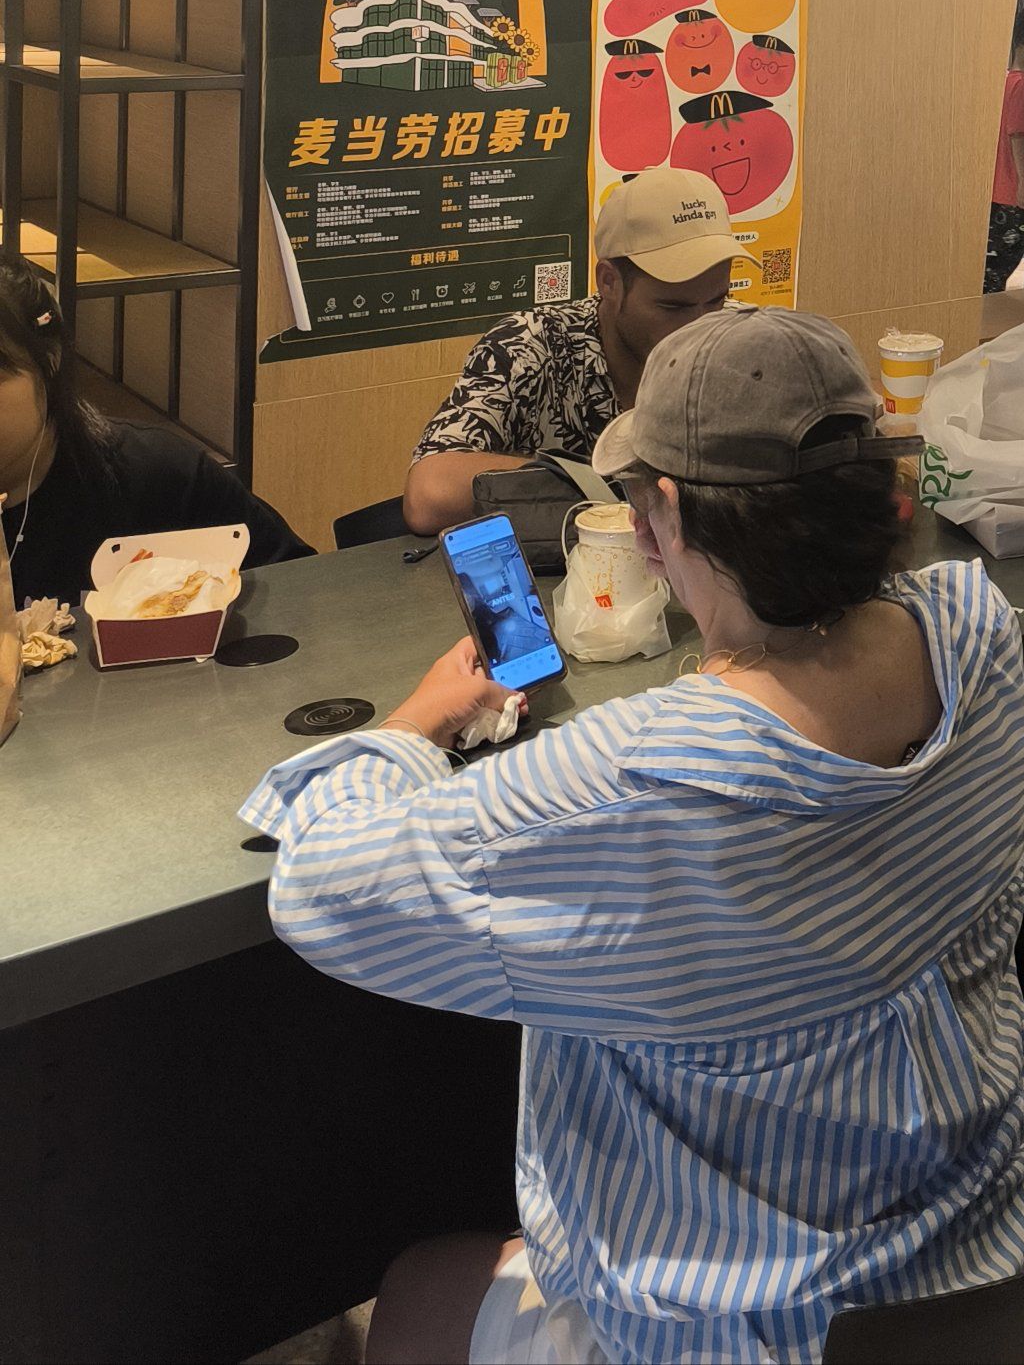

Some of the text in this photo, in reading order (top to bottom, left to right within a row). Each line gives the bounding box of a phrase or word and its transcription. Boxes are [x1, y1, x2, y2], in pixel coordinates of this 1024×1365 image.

[288, 106, 571, 167] 麦当劳招募中
[681, 198, 707, 211] lucky
[672, 209, 717, 224] kinda guy
[410, 249, 459, 266] 福利待遇
